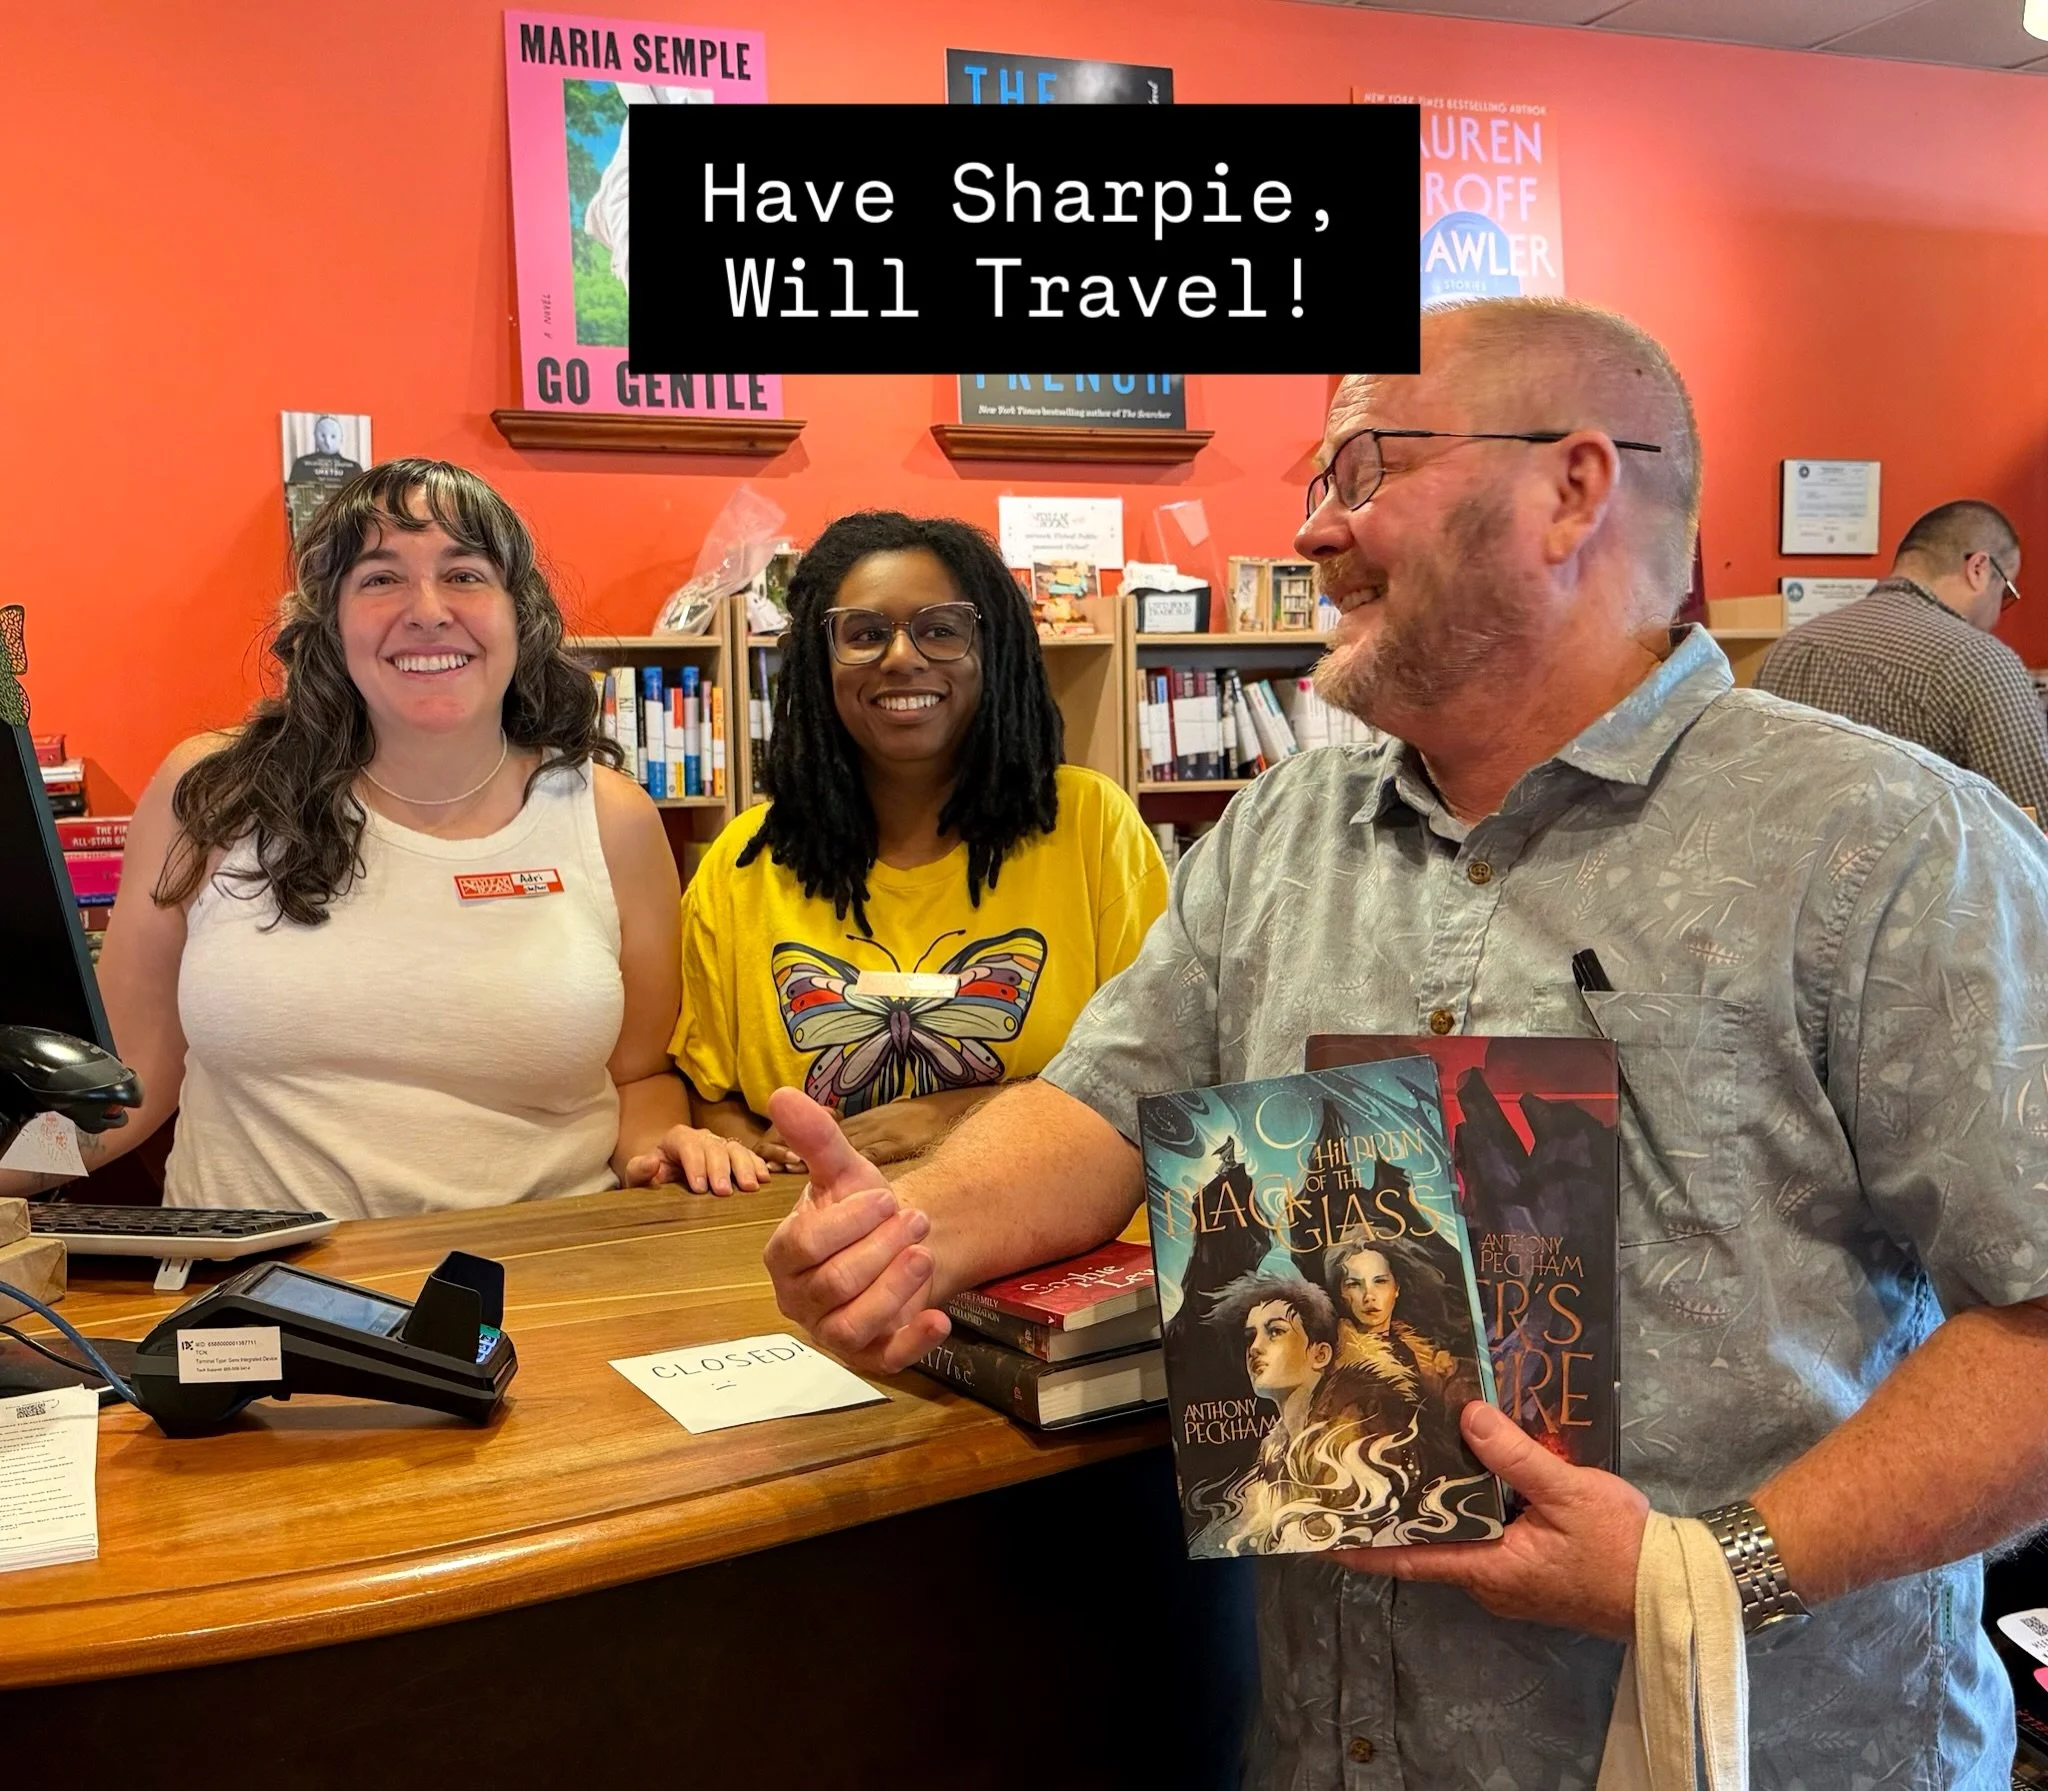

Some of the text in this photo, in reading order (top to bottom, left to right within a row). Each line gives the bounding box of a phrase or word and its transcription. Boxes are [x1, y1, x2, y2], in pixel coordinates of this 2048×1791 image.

[520, 23, 751, 80] MARIA SEMPLE
[964, 64, 1057, 104] THE
[1446, 98, 1507, 113] BESTSELLING
[1509, 104, 1547, 116] AUTHOR
[1420, 113, 1542, 165] UREN
[1424, 171, 1537, 222] ROFF
[1420, 230, 1557, 278] AWLER
[537, 356, 768, 411] GO GENTLE
[72, 836, 126, 847] ALL-STAR GA
[95, 825, 128, 835] THE FIR
[520, 873, 543, 883] Adri
[1305, 1167, 1368, 1192] OF THE
[1163, 1174, 1312, 1237] BLACK
[1275, 1184, 1440, 1253] GLASS
[1480, 1233, 1564, 1255] ANTHONY
[1480, 1250, 1584, 1278] PECKHAM
[1020, 1265, 1124, 1295] Sophie
[972, 1293, 999, 1309] FAMILY
[651, 1341, 813, 1379] CLOSED!
[954, 1366, 975, 1387] B.C.
[1183, 1397, 1258, 1423] ANTHONY
[1183, 1414, 1282, 1445] PECKHAM
